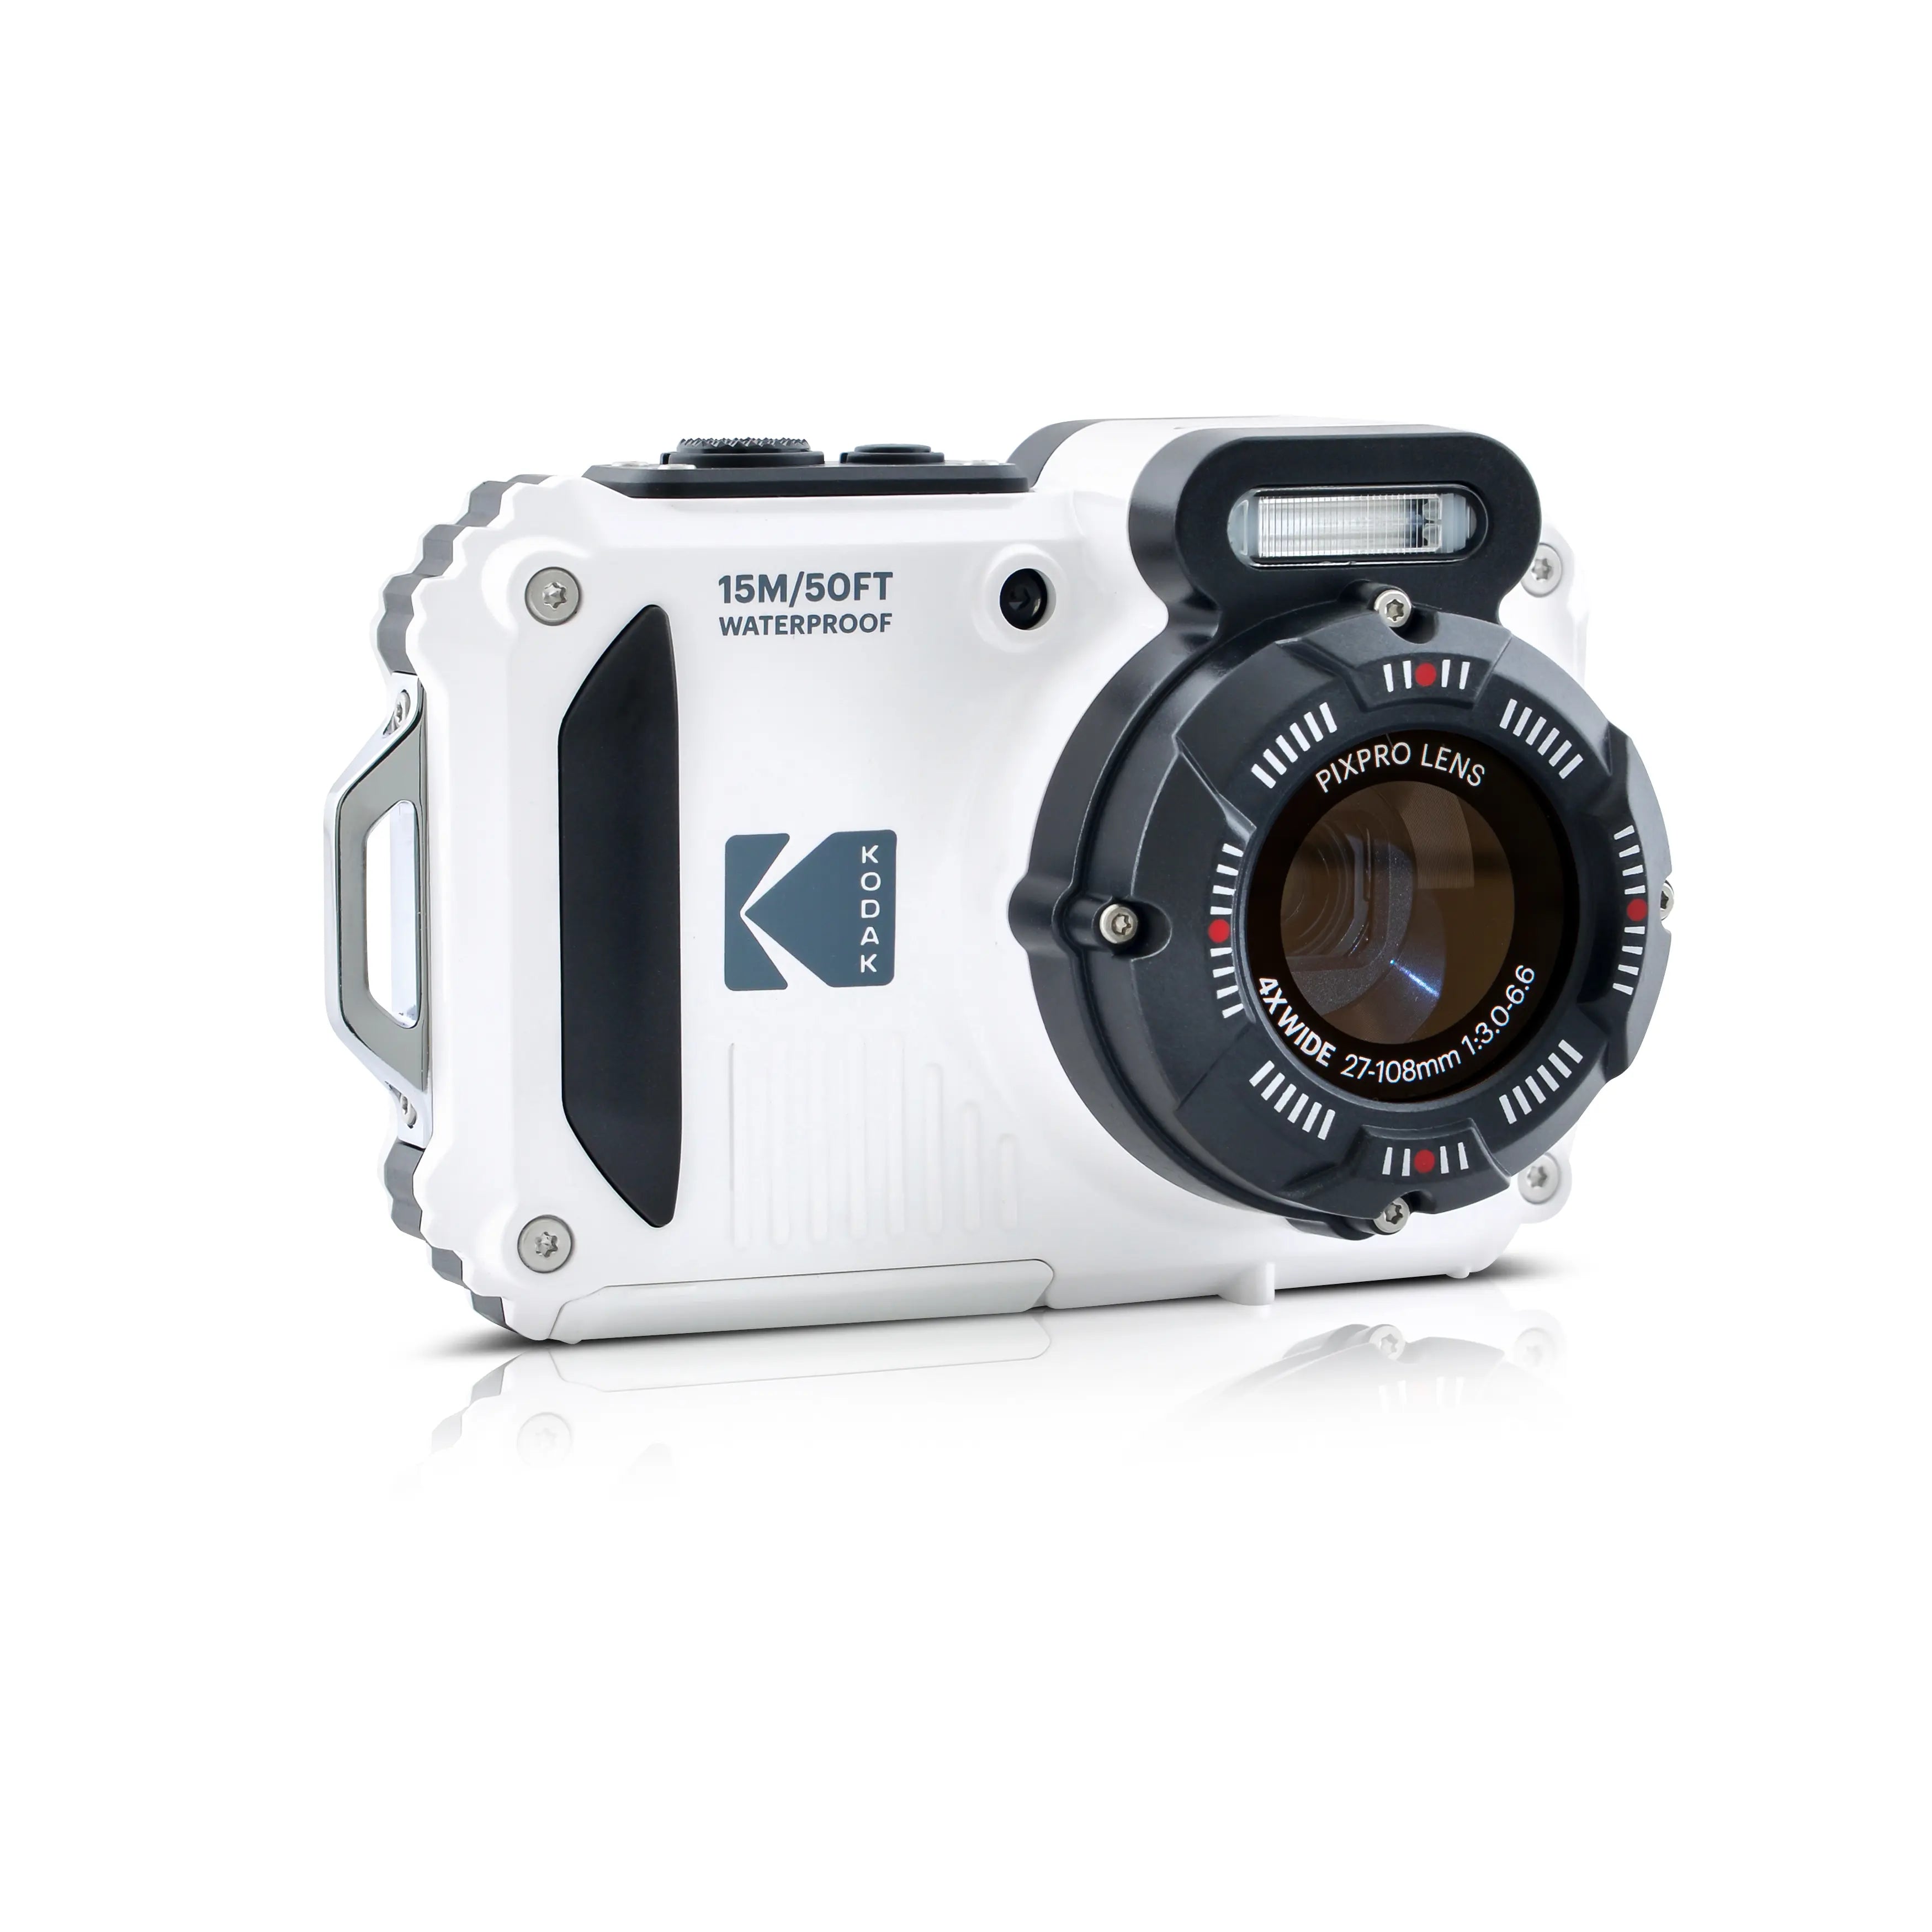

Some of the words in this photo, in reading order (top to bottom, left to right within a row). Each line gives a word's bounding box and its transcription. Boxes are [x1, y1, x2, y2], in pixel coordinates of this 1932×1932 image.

[718, 571, 894, 608] 15M/50FT
[719, 613, 893, 636] WATERPROOF
[1315, 742, 1411, 793] PIXPRO
[1421, 743, 1485, 787] LENS
[860, 845, 882, 973] KODAK
[1340, 1050, 1462, 1083] 27-108mm
[1461, 965, 1535, 1055] 1:3.0-6.6
